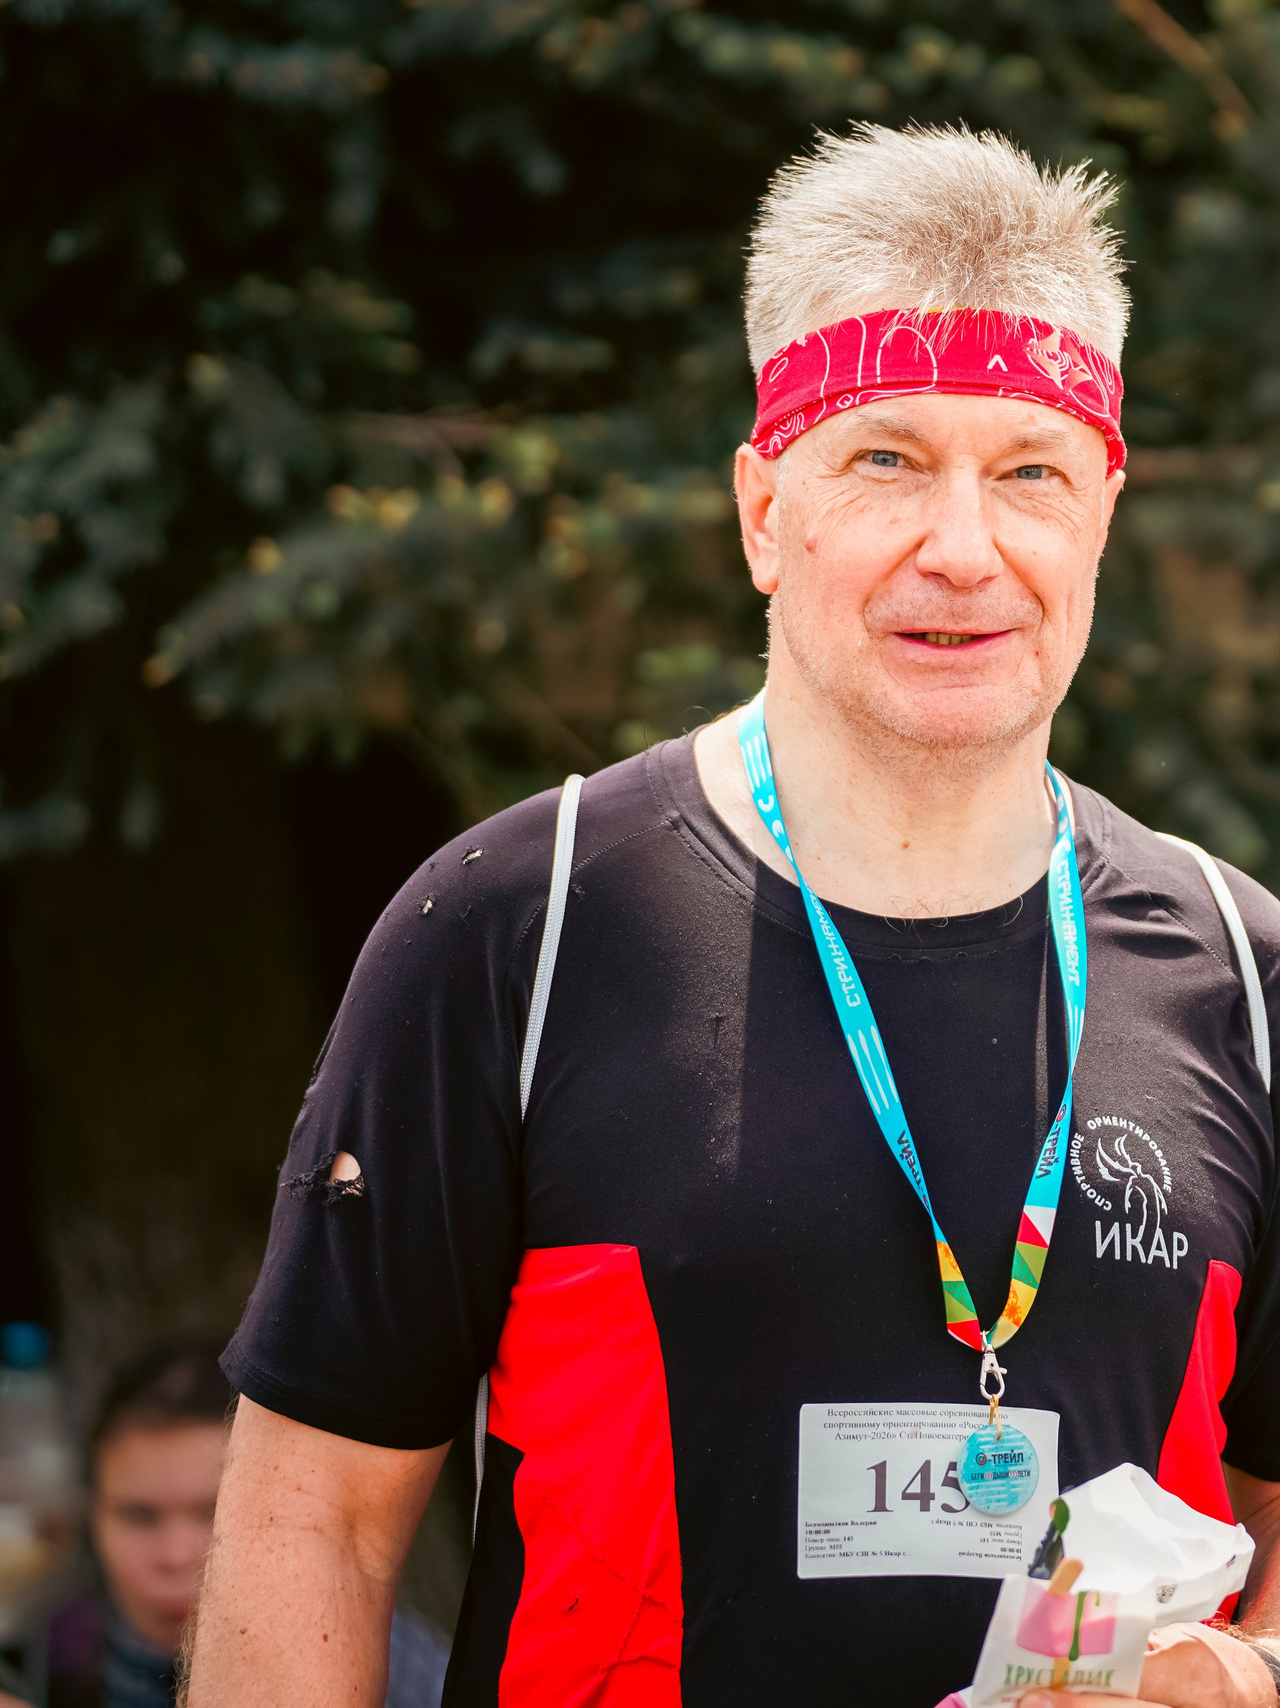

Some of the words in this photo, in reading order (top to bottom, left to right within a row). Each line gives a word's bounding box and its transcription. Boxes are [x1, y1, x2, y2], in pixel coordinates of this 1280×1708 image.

[1070, 1132, 1112, 1211] СПОРТИВНОЕ
[1086, 1115, 1172, 1193] ОРИЕНТИРОВАНИЕ
[1095, 1220, 1189, 1269] ИКАР
[823, 1421, 880, 1430] спортивному
[882, 1421, 956, 1430] ориентированию
[827, 1409, 893, 1418] Всероссийские
[939, 1410, 997, 1418] соревновани
[835, 1431, 897, 1441] Азимут-2026»
[866, 1459, 971, 1514] 145
